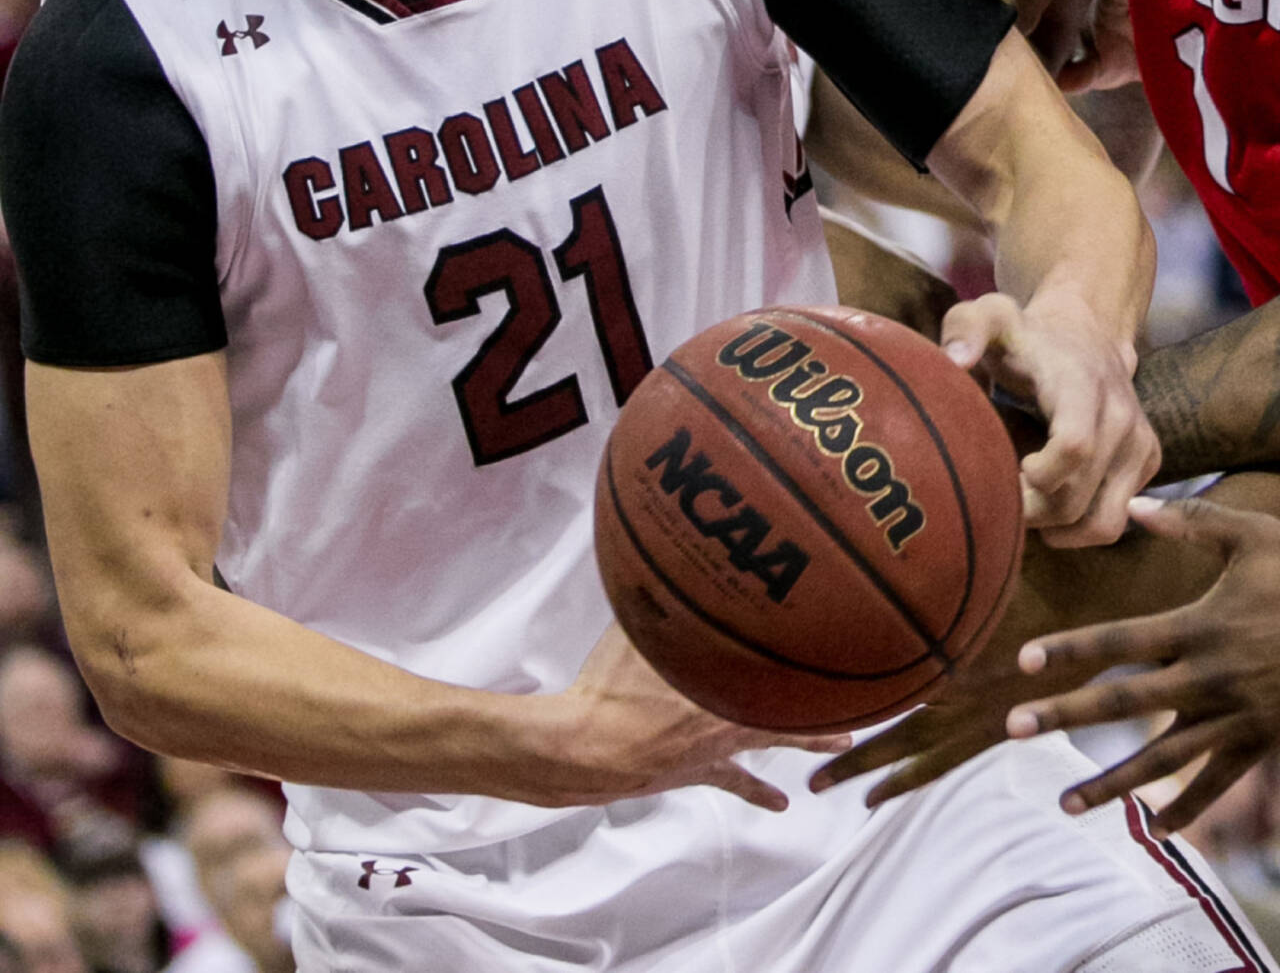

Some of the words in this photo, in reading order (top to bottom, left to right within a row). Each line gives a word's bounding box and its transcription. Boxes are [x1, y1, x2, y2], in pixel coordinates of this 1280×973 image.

[283, 38, 667, 239] CAROLINA
[1174, 27, 1237, 196] 1
[423, 185, 654, 467] 21
[645, 427, 810, 604] NCAA
[716, 321, 926, 555] Wilson
